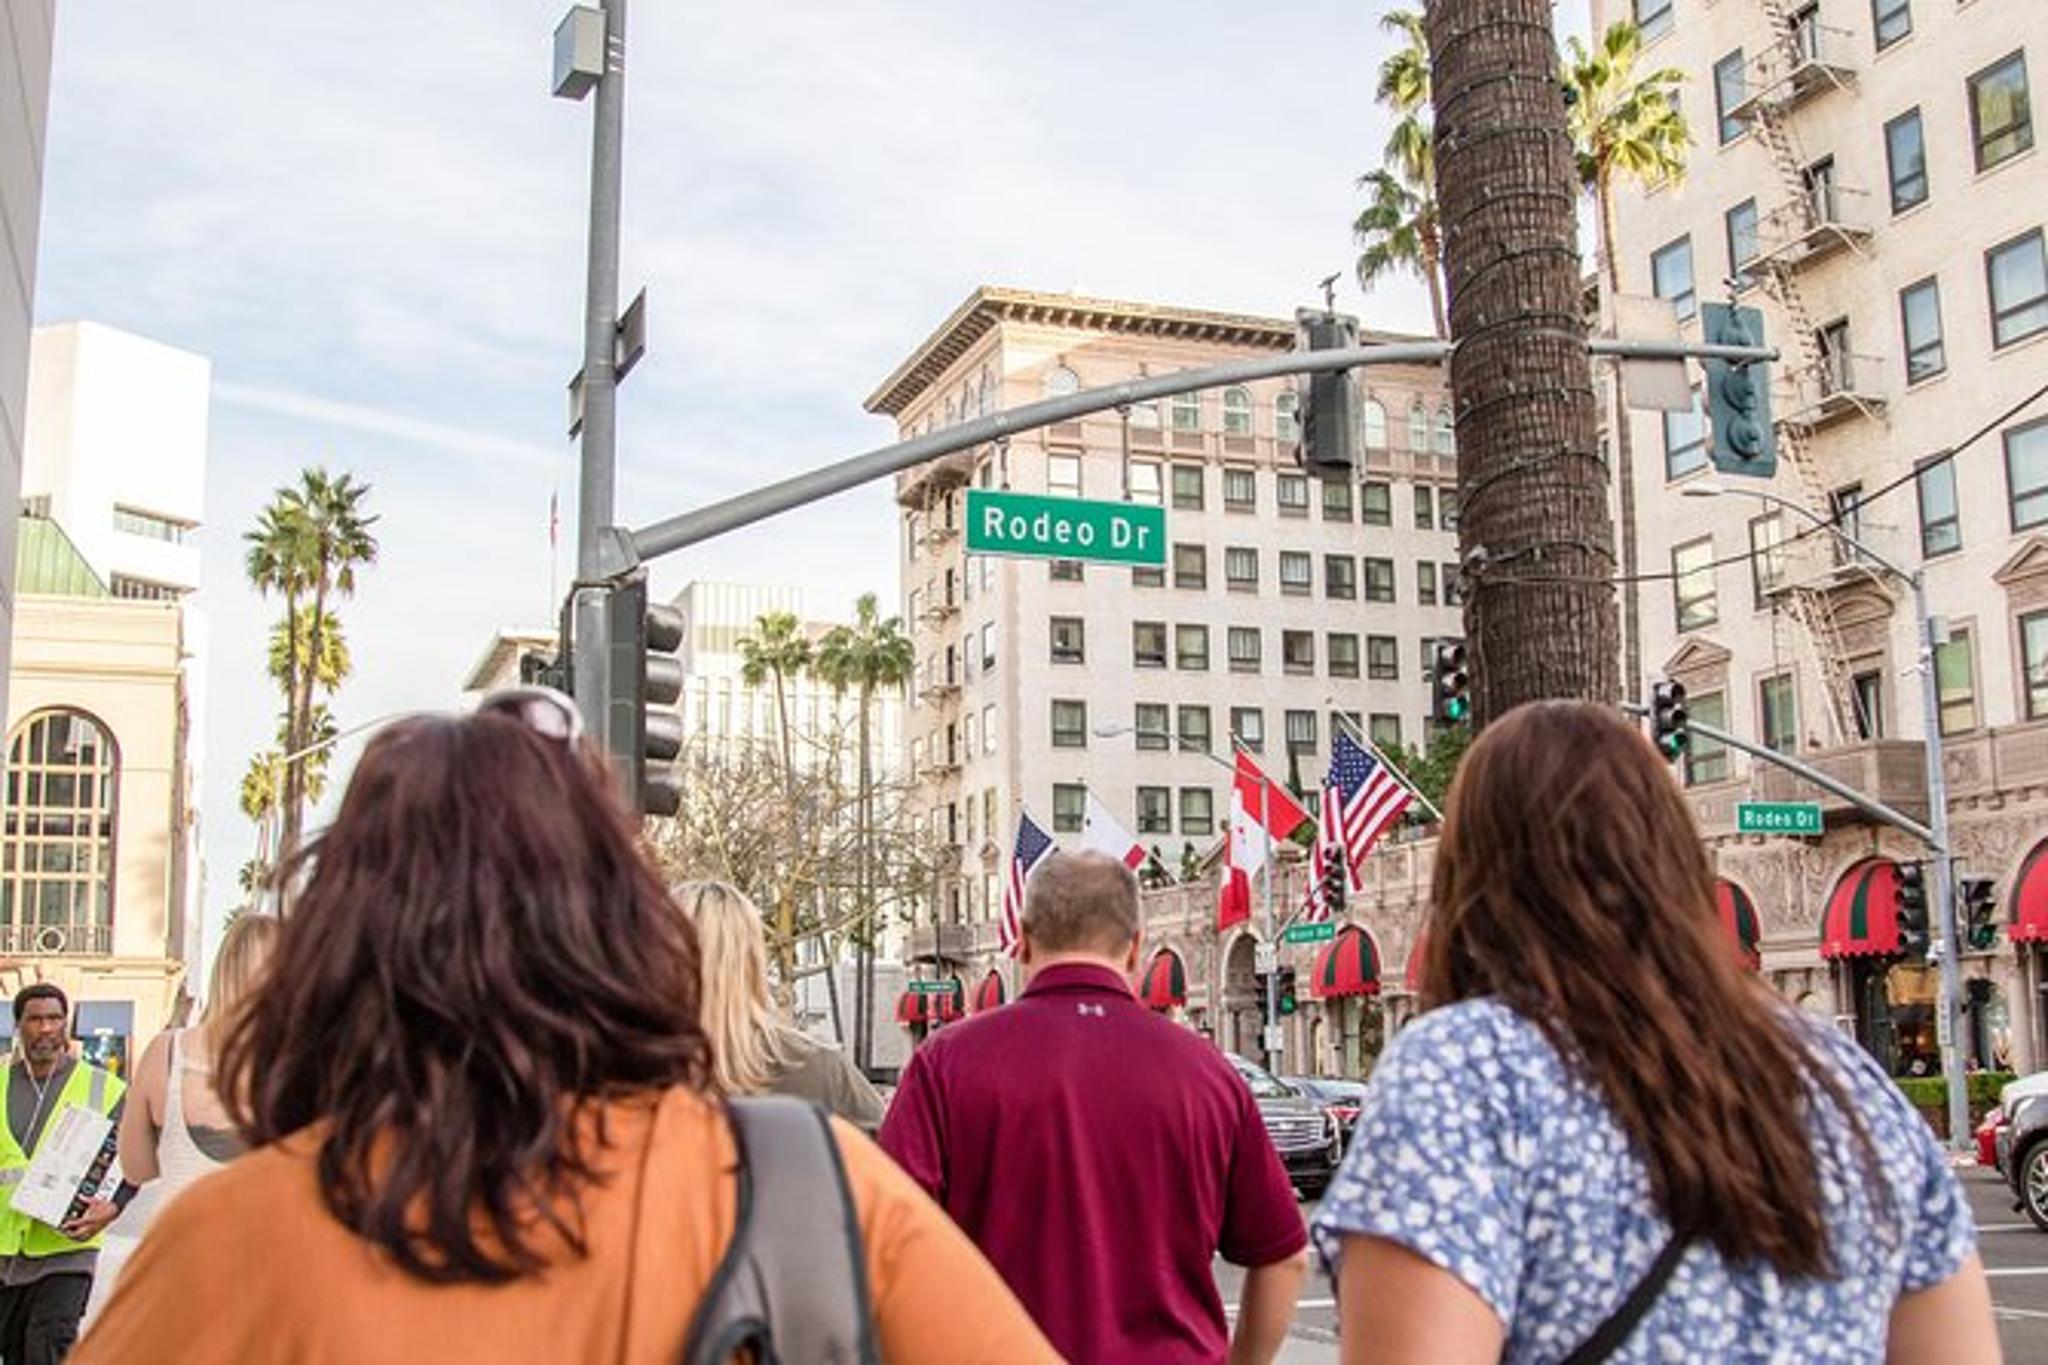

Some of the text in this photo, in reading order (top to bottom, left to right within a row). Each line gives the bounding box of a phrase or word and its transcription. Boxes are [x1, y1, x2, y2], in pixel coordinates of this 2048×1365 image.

[984, 507, 1151, 550] Rodeo Dr
[1743, 810, 1814, 827] Rodeo Dr
